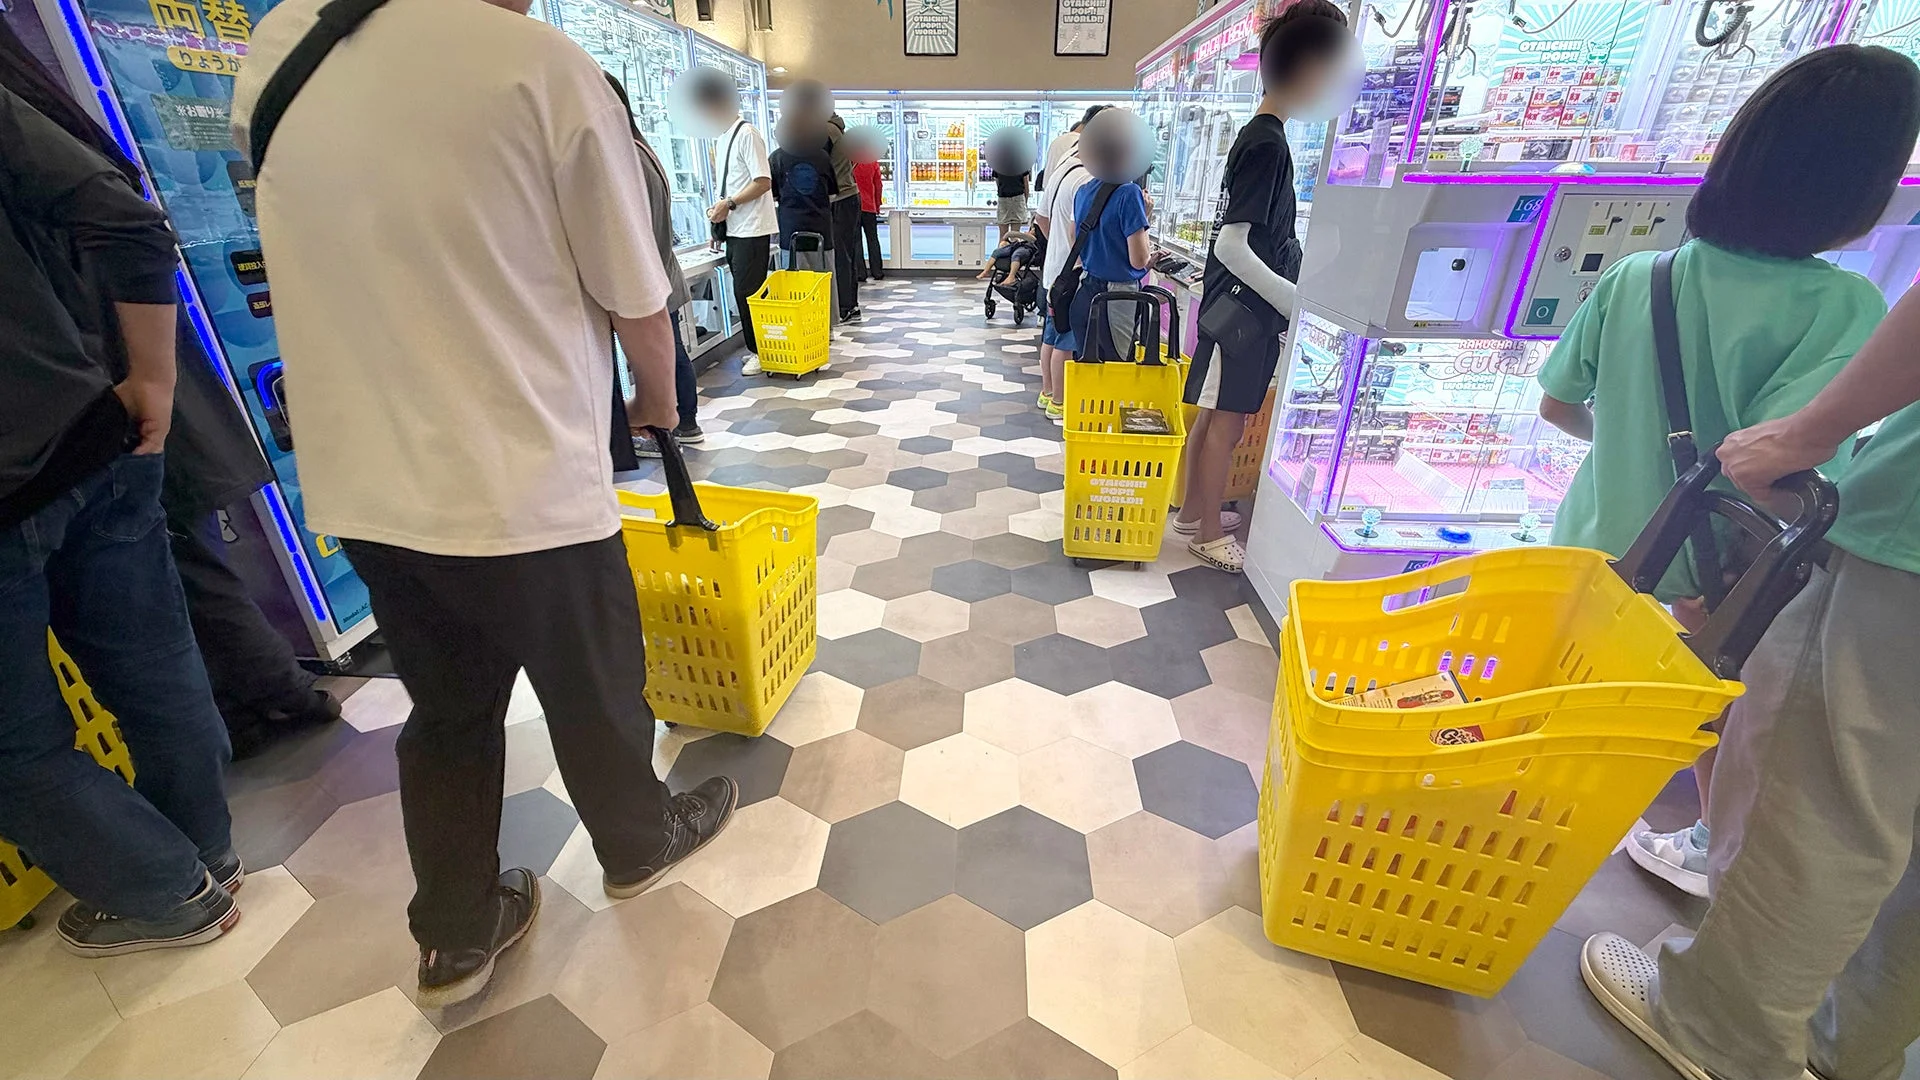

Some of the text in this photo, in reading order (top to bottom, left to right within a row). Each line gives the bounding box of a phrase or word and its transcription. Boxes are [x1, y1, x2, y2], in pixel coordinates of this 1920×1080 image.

[147, 0, 252, 42] 両替
[1515, 199, 1544, 211] 168
[1209, 557, 1235, 571] crocs
